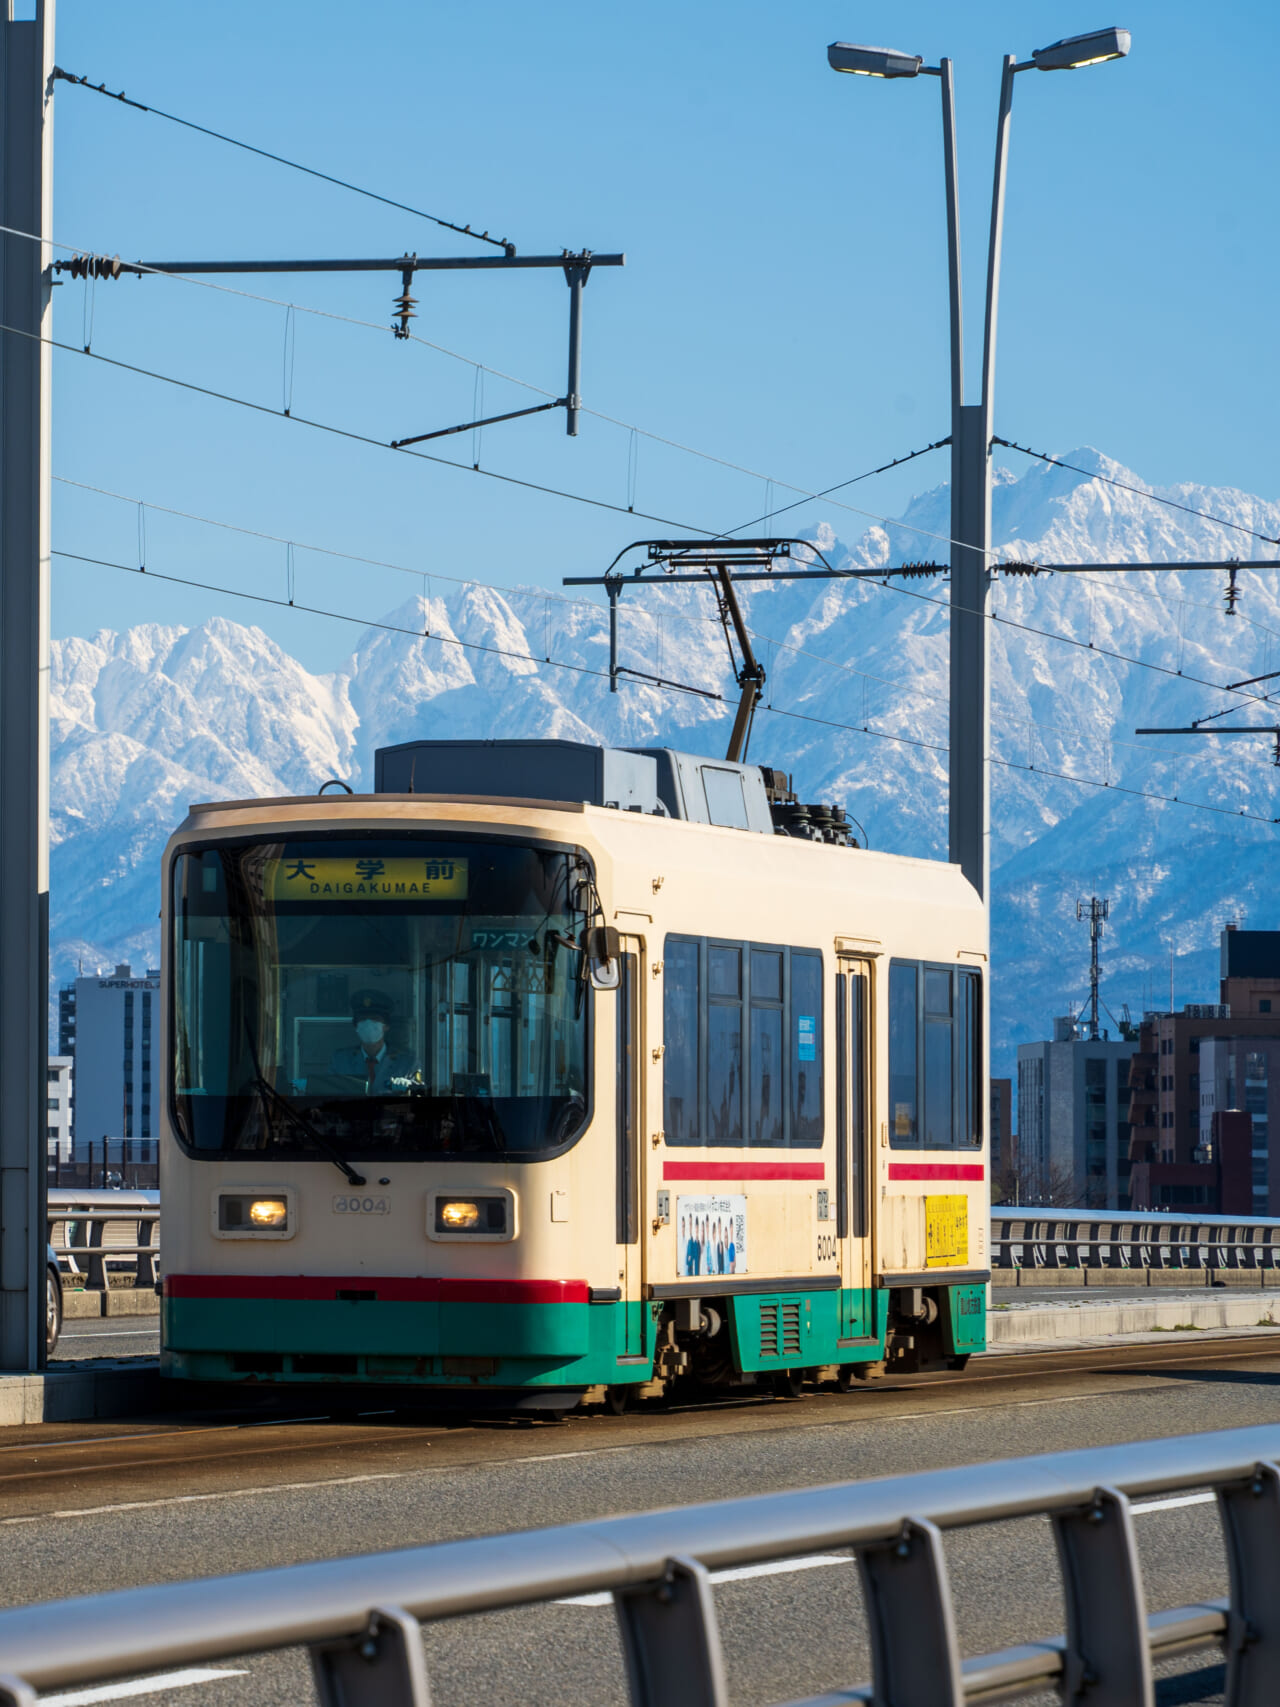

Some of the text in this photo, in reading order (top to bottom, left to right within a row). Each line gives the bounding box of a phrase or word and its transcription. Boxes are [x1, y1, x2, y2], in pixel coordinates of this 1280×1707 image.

[285, 859, 455, 881] 大学前
[310, 882, 431, 894] DAIGAKUMAE
[473, 932, 535, 948] ワンマン
[335, 1197, 387, 1213] 8004
[817, 1234, 837, 1261] 8004
